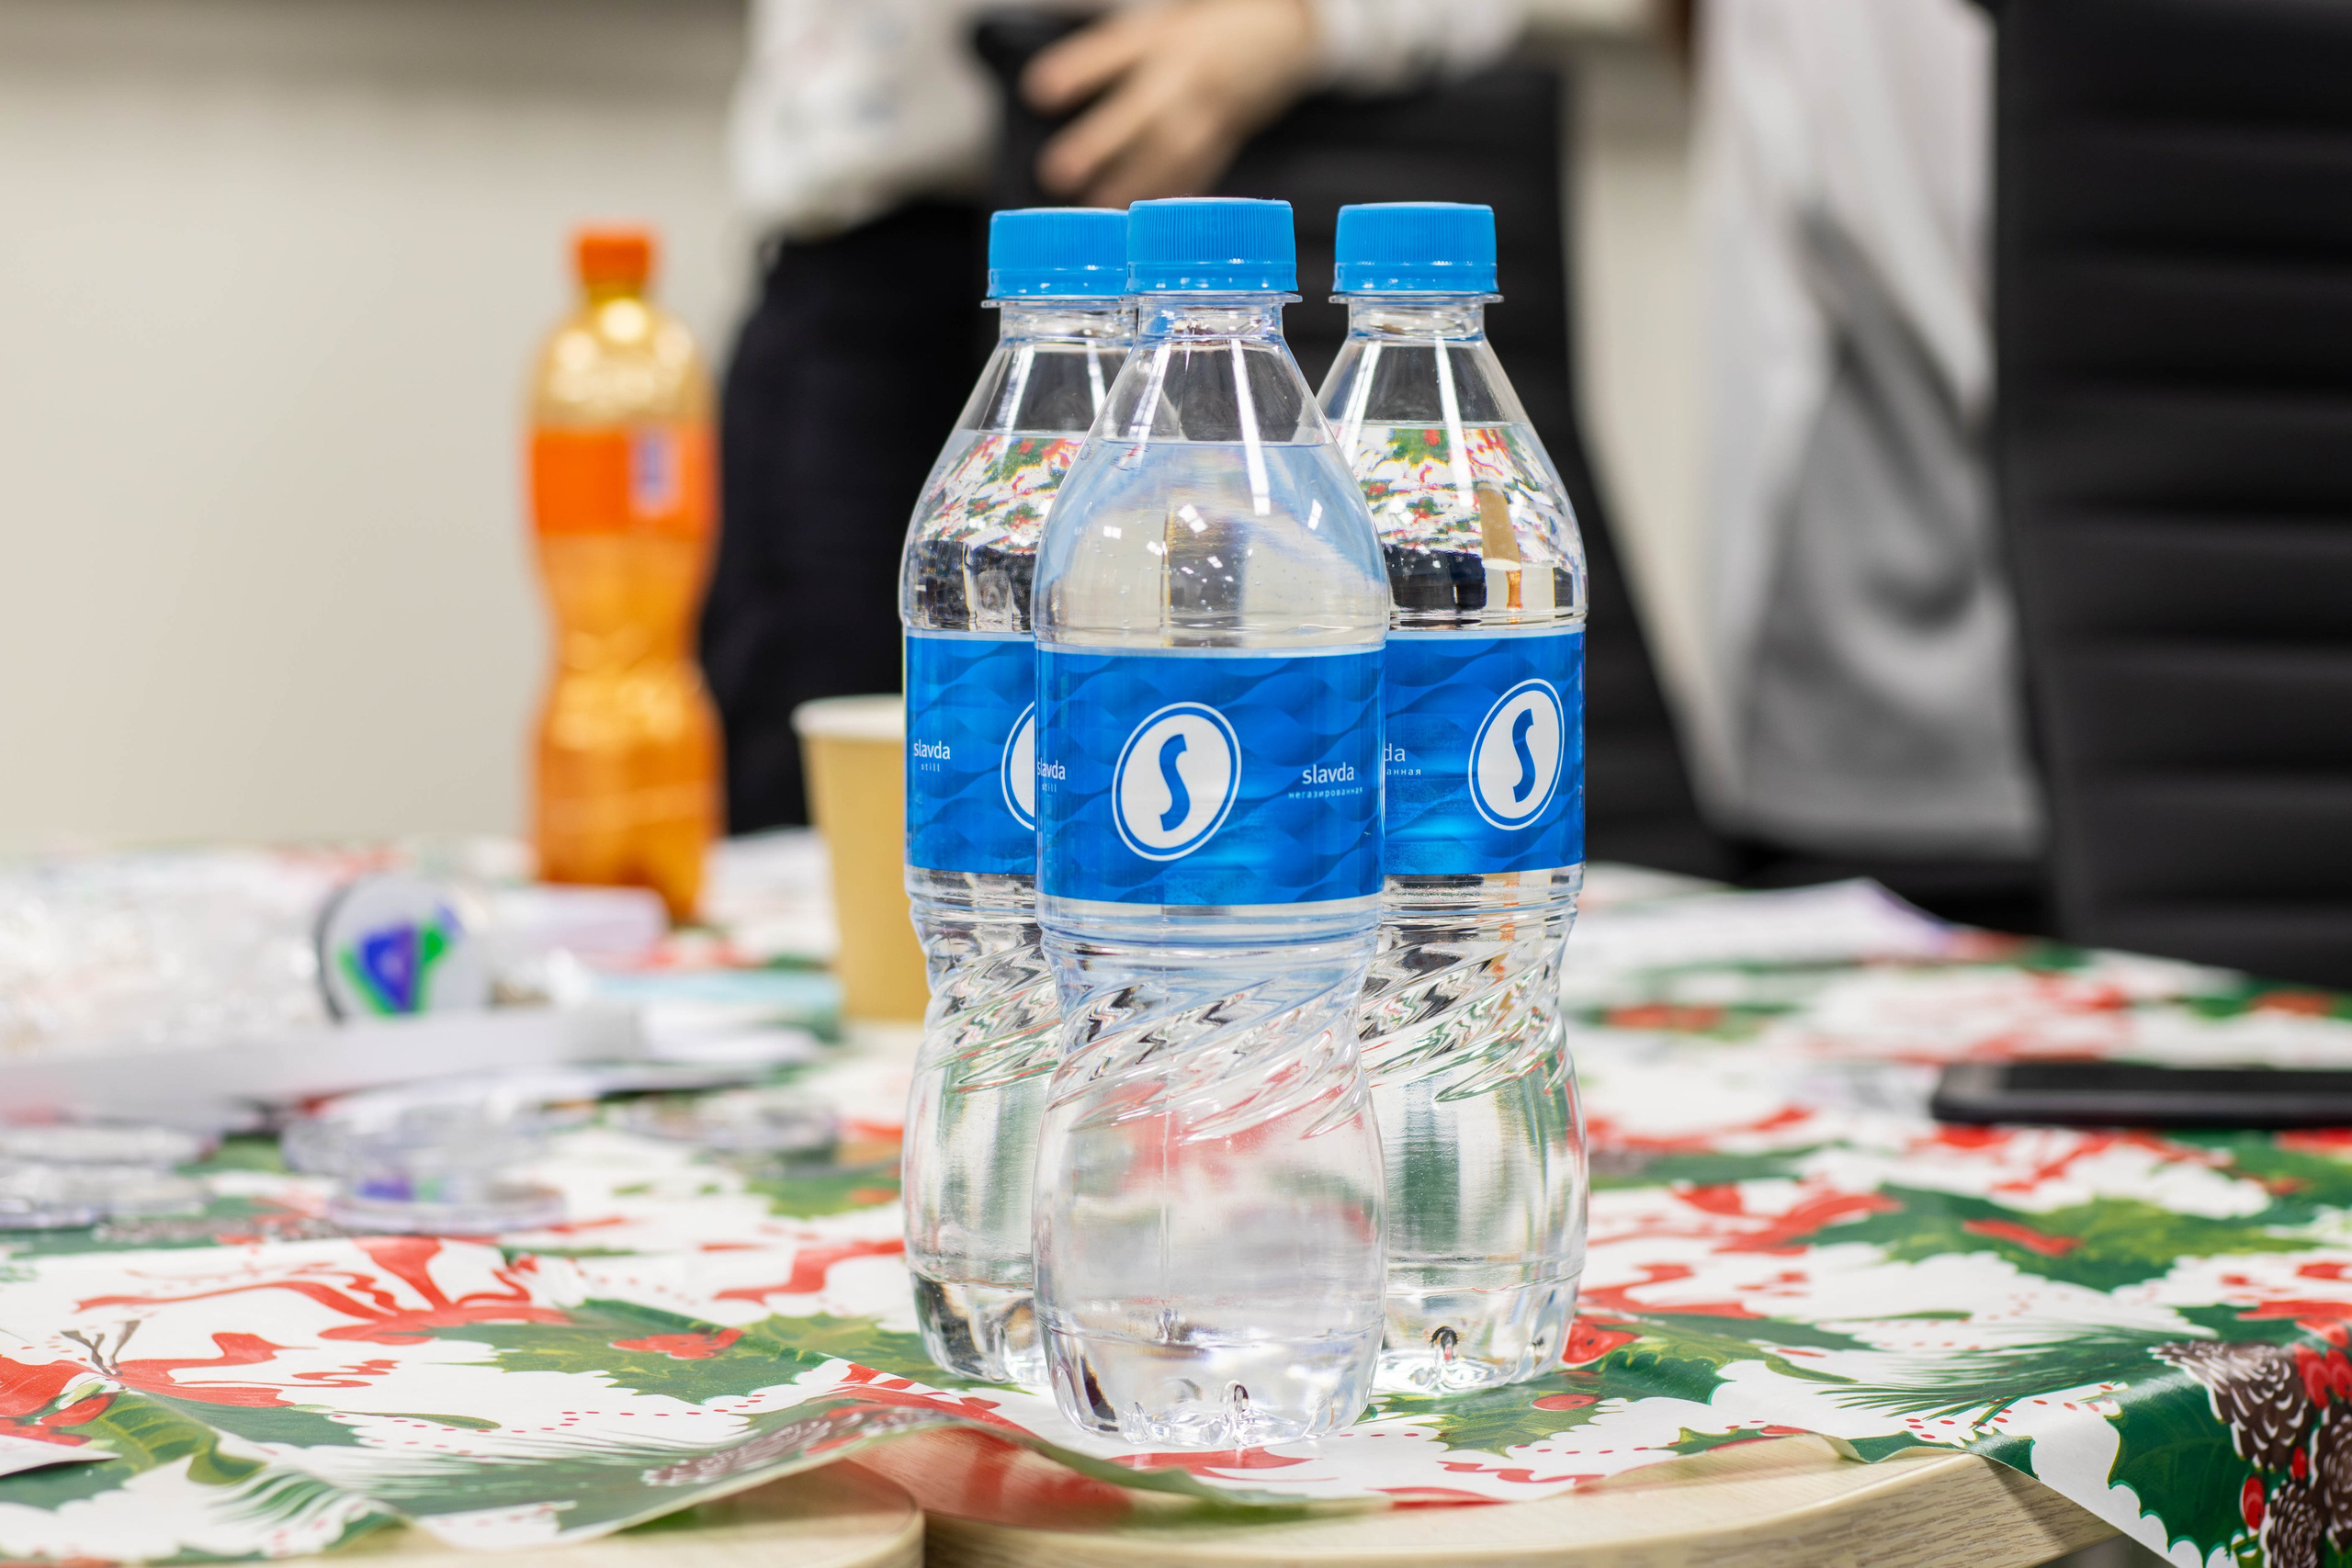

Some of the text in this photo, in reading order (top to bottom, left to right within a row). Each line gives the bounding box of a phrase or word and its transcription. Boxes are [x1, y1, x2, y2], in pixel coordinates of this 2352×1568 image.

[913, 739, 951, 760] slavda
[921, 763, 941, 773] still
[1036, 758, 1066, 781] slavda
[1302, 761, 1355, 784] slavda
[1287, 787, 1363, 800] негазированная
